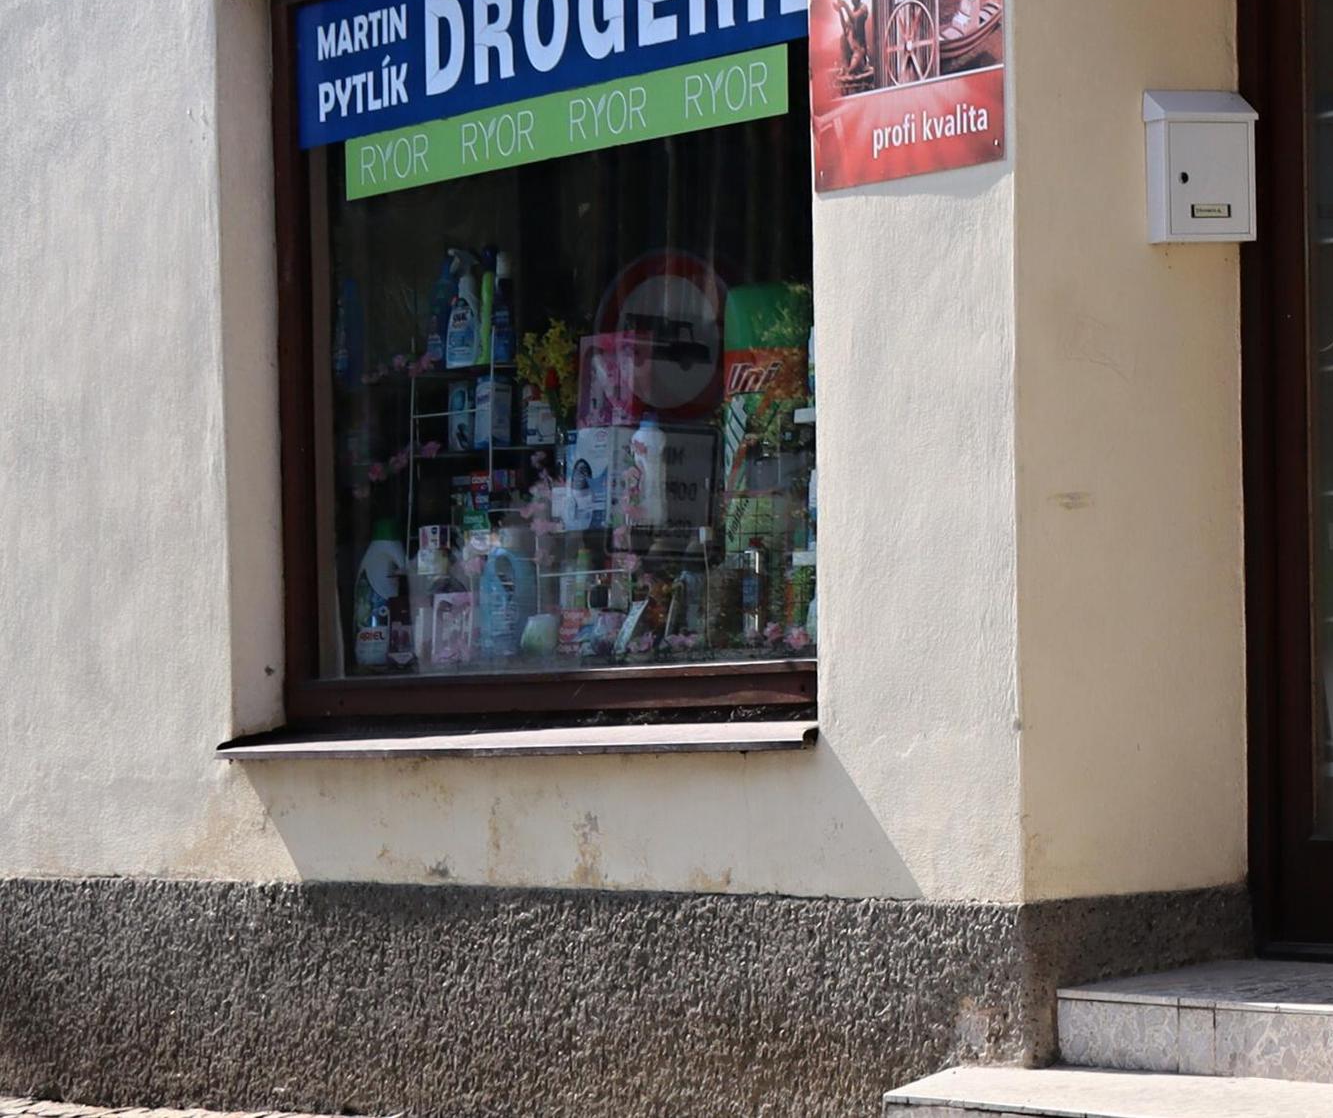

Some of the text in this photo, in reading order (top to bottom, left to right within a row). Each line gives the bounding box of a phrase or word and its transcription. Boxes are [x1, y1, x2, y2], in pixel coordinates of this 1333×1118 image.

[316, 3, 408, 61] MARTIN
[317, 53, 409, 123] PYTLÍK
[361, 61, 768, 185] RYOR RYOR RYOR RYOR
[873, 103, 989, 159] profi kvalita
